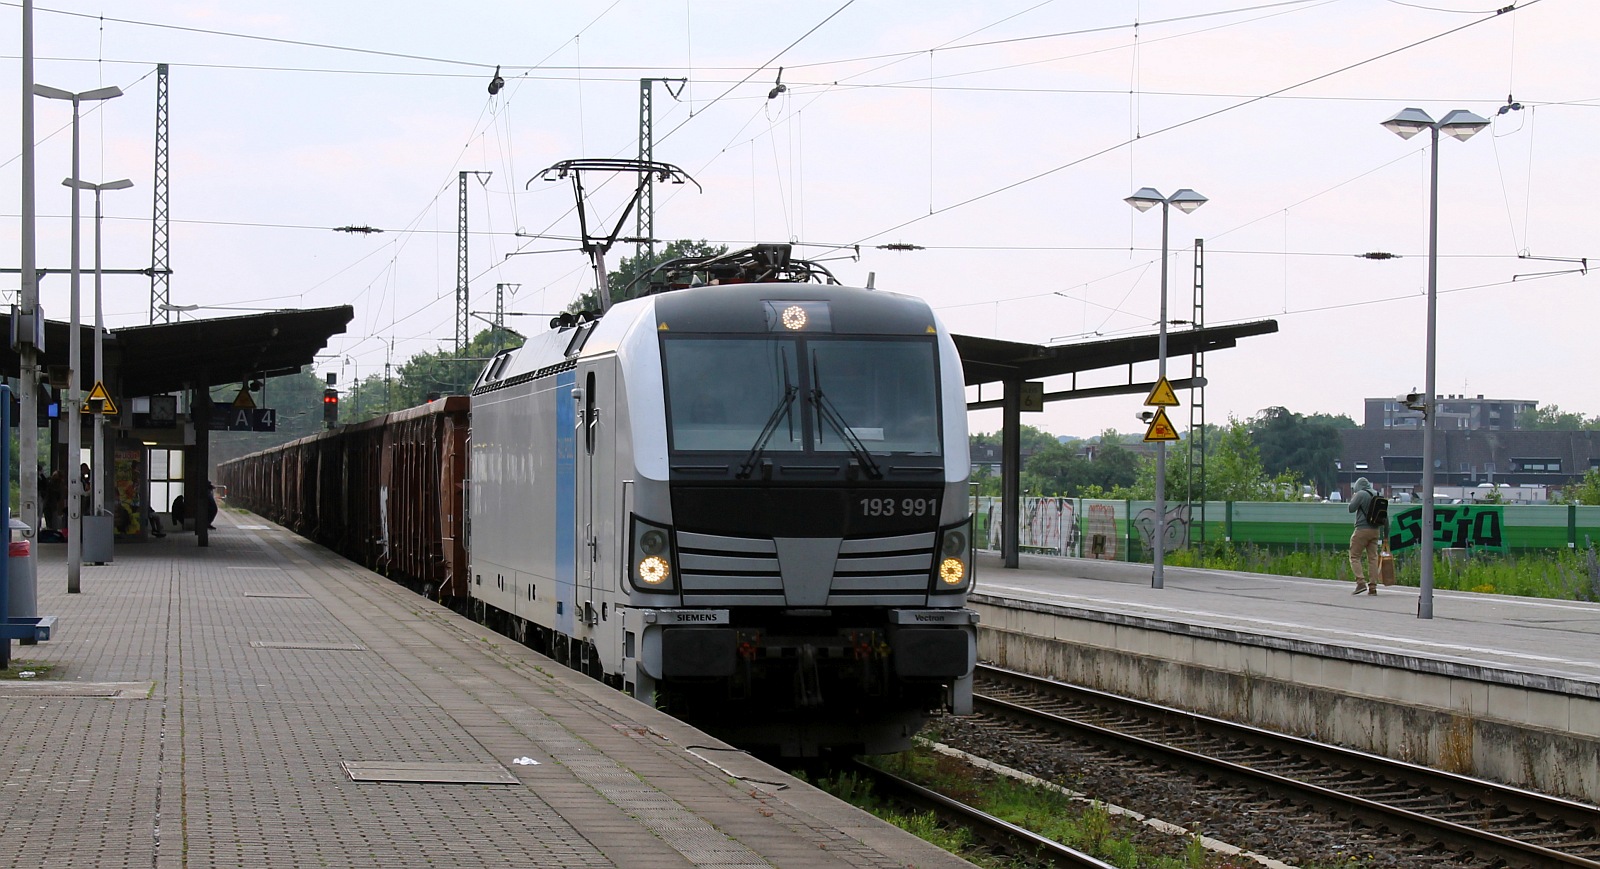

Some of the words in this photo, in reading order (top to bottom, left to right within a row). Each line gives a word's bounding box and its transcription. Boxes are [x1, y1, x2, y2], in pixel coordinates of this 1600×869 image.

[235, 410, 249, 426] A
[261, 410, 272, 427] 4
[860, 498, 895, 517] 193
[902, 498, 936, 517] 991
[677, 613, 717, 622] SIEMENS
[915, 614, 944, 622] Vectron
